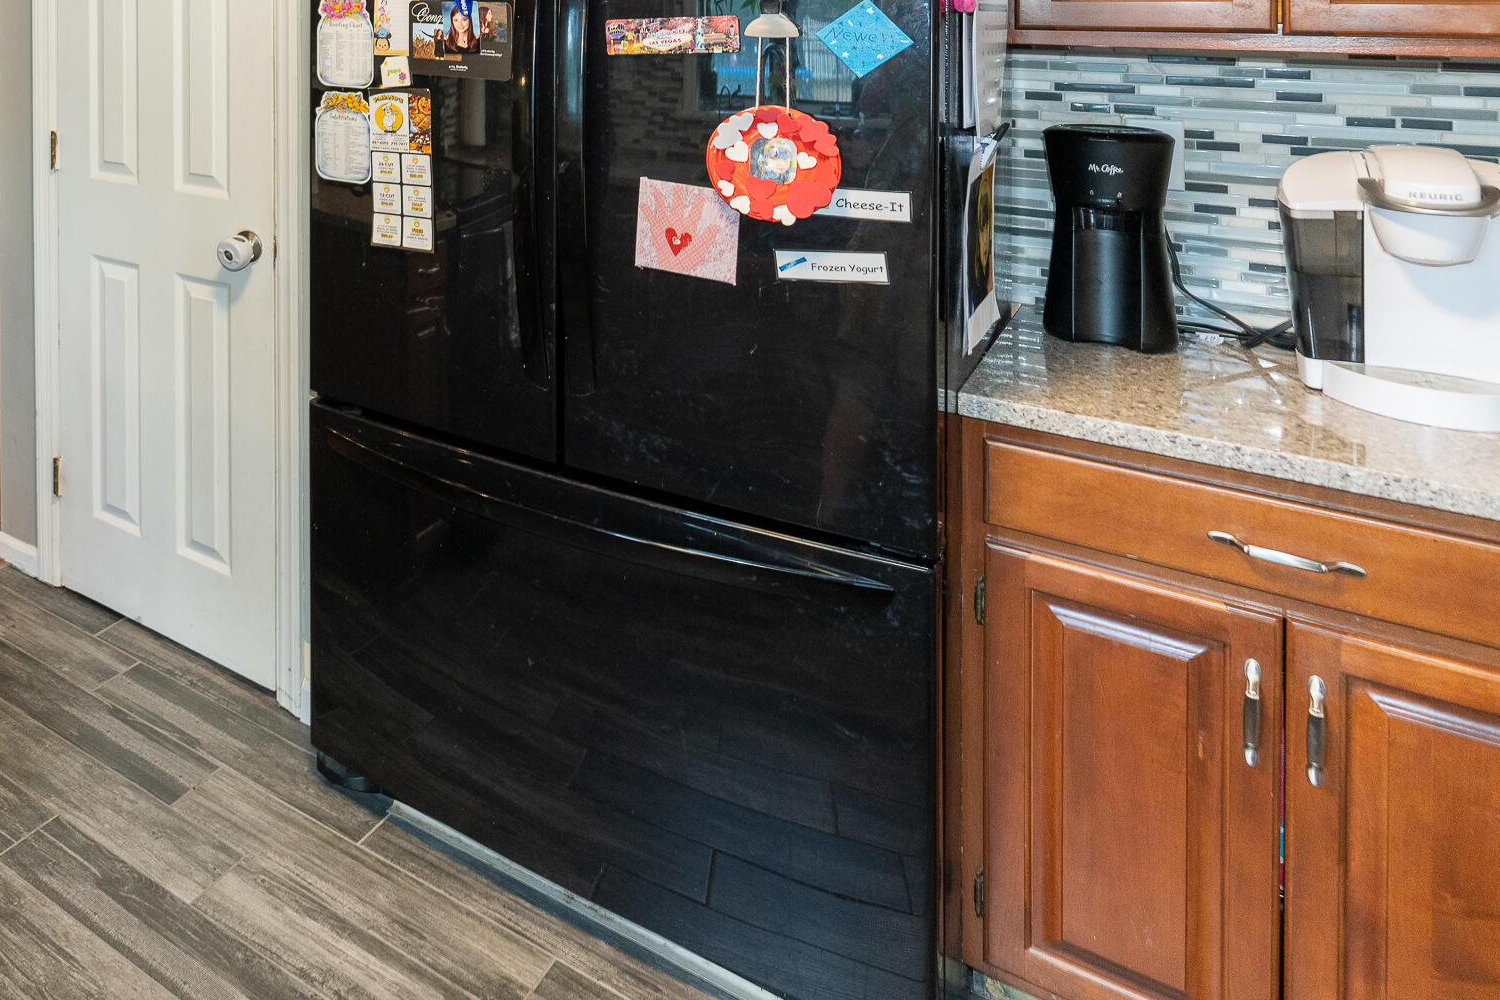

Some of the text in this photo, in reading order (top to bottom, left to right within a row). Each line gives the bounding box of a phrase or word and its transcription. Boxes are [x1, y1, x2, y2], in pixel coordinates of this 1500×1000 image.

[411, 2, 443, 22] Cong
[1101, 164, 1123, 175] Coffee
[1409, 191, 1464, 200] KEURIG
[835, 198, 904, 212] Cheese-It
[810, 262, 884, 275] Frozen Yogurt
